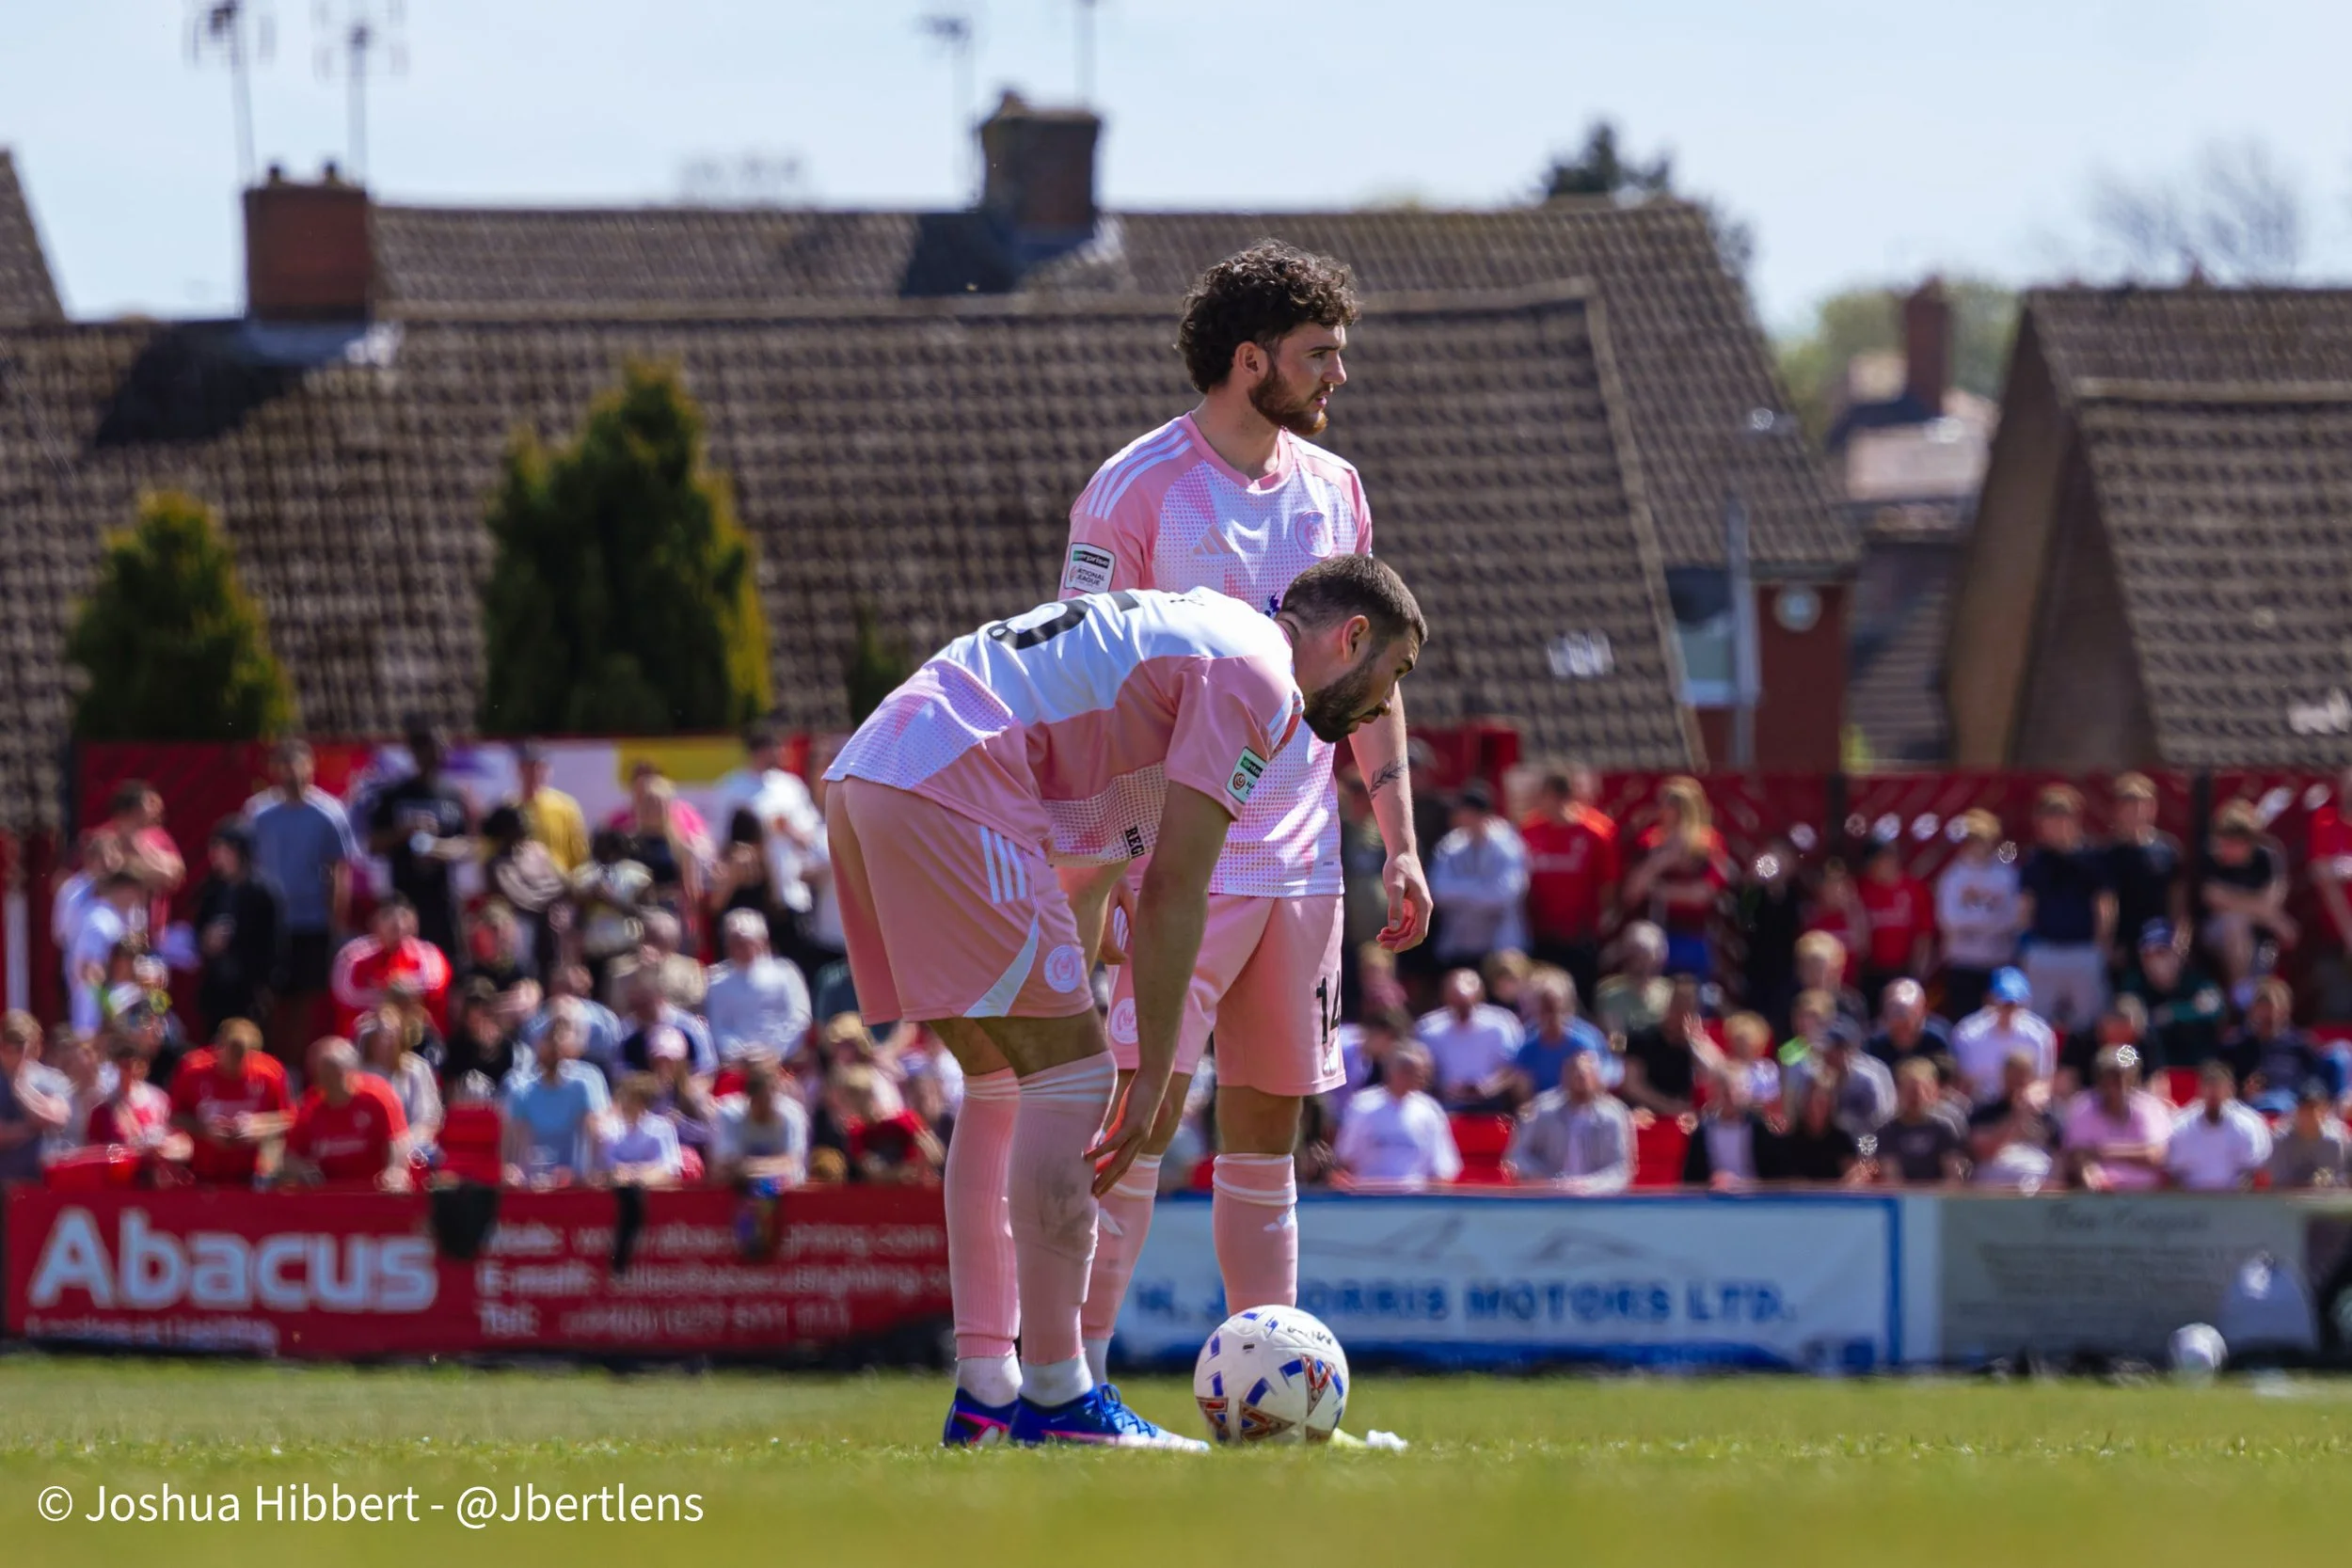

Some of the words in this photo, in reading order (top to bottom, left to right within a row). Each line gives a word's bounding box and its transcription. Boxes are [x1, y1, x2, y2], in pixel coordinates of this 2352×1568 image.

[1316, 970, 1341, 1045] 14
[29, 1208, 437, 1310] Abacus
[1298, 1280, 1446, 1319] ORRIS
[1462, 1280, 1672, 1320] MOTORS
